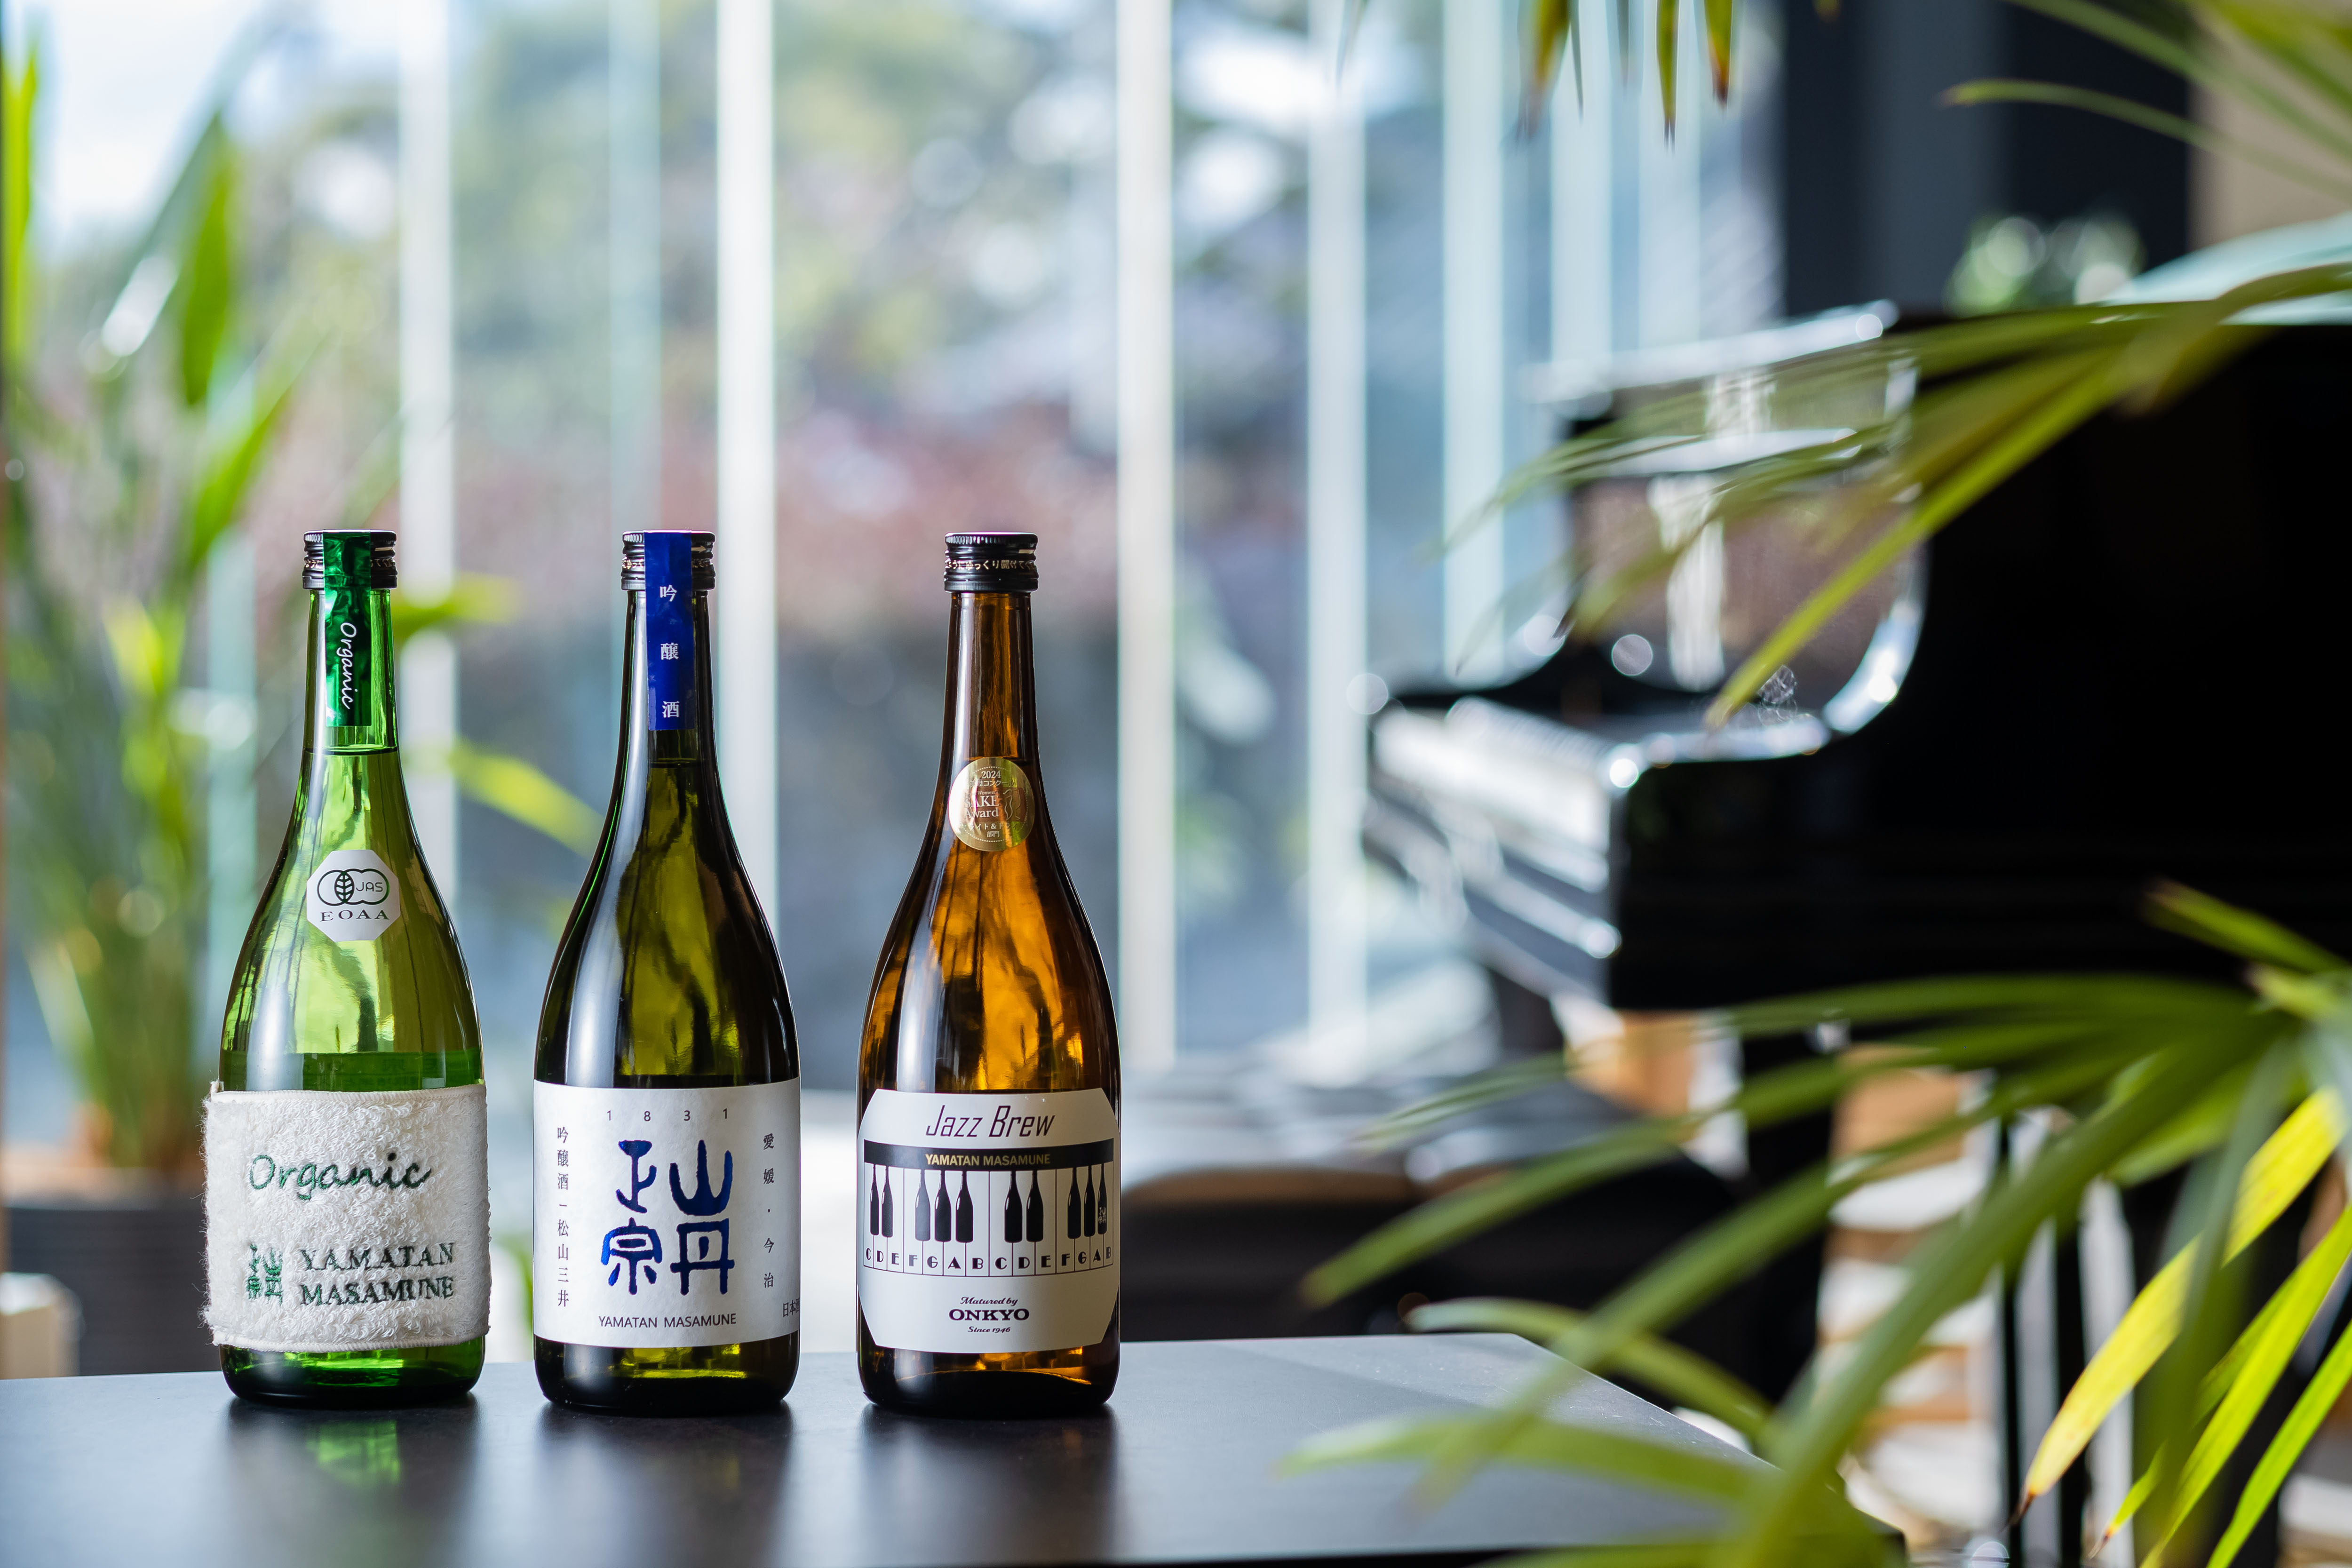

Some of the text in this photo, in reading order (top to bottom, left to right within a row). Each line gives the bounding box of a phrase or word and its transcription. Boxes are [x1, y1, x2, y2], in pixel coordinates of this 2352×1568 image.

[660, 585, 680, 718] 吟醸酒
[336, 622, 358, 709] Organic
[981, 771, 1001, 779] 2024
[965, 807, 999, 819] Award
[356, 882, 383, 892] JAS
[320, 909, 390, 922] EOAA
[926, 1105, 1055, 1138] Jazz Brew
[925, 1154, 1050, 1166] YAMATAN MASAMUNE
[250, 1153, 431, 1201] Organic
[300, 1242, 454, 1271] YAMATAN
[300, 1276, 454, 1306] MASAMUNE
[1006, 1297, 1018, 1306] by
[599, 1313, 736, 1328] YAMATAN MASAMUNE
[949, 1308, 1029, 1321] ONKYO
